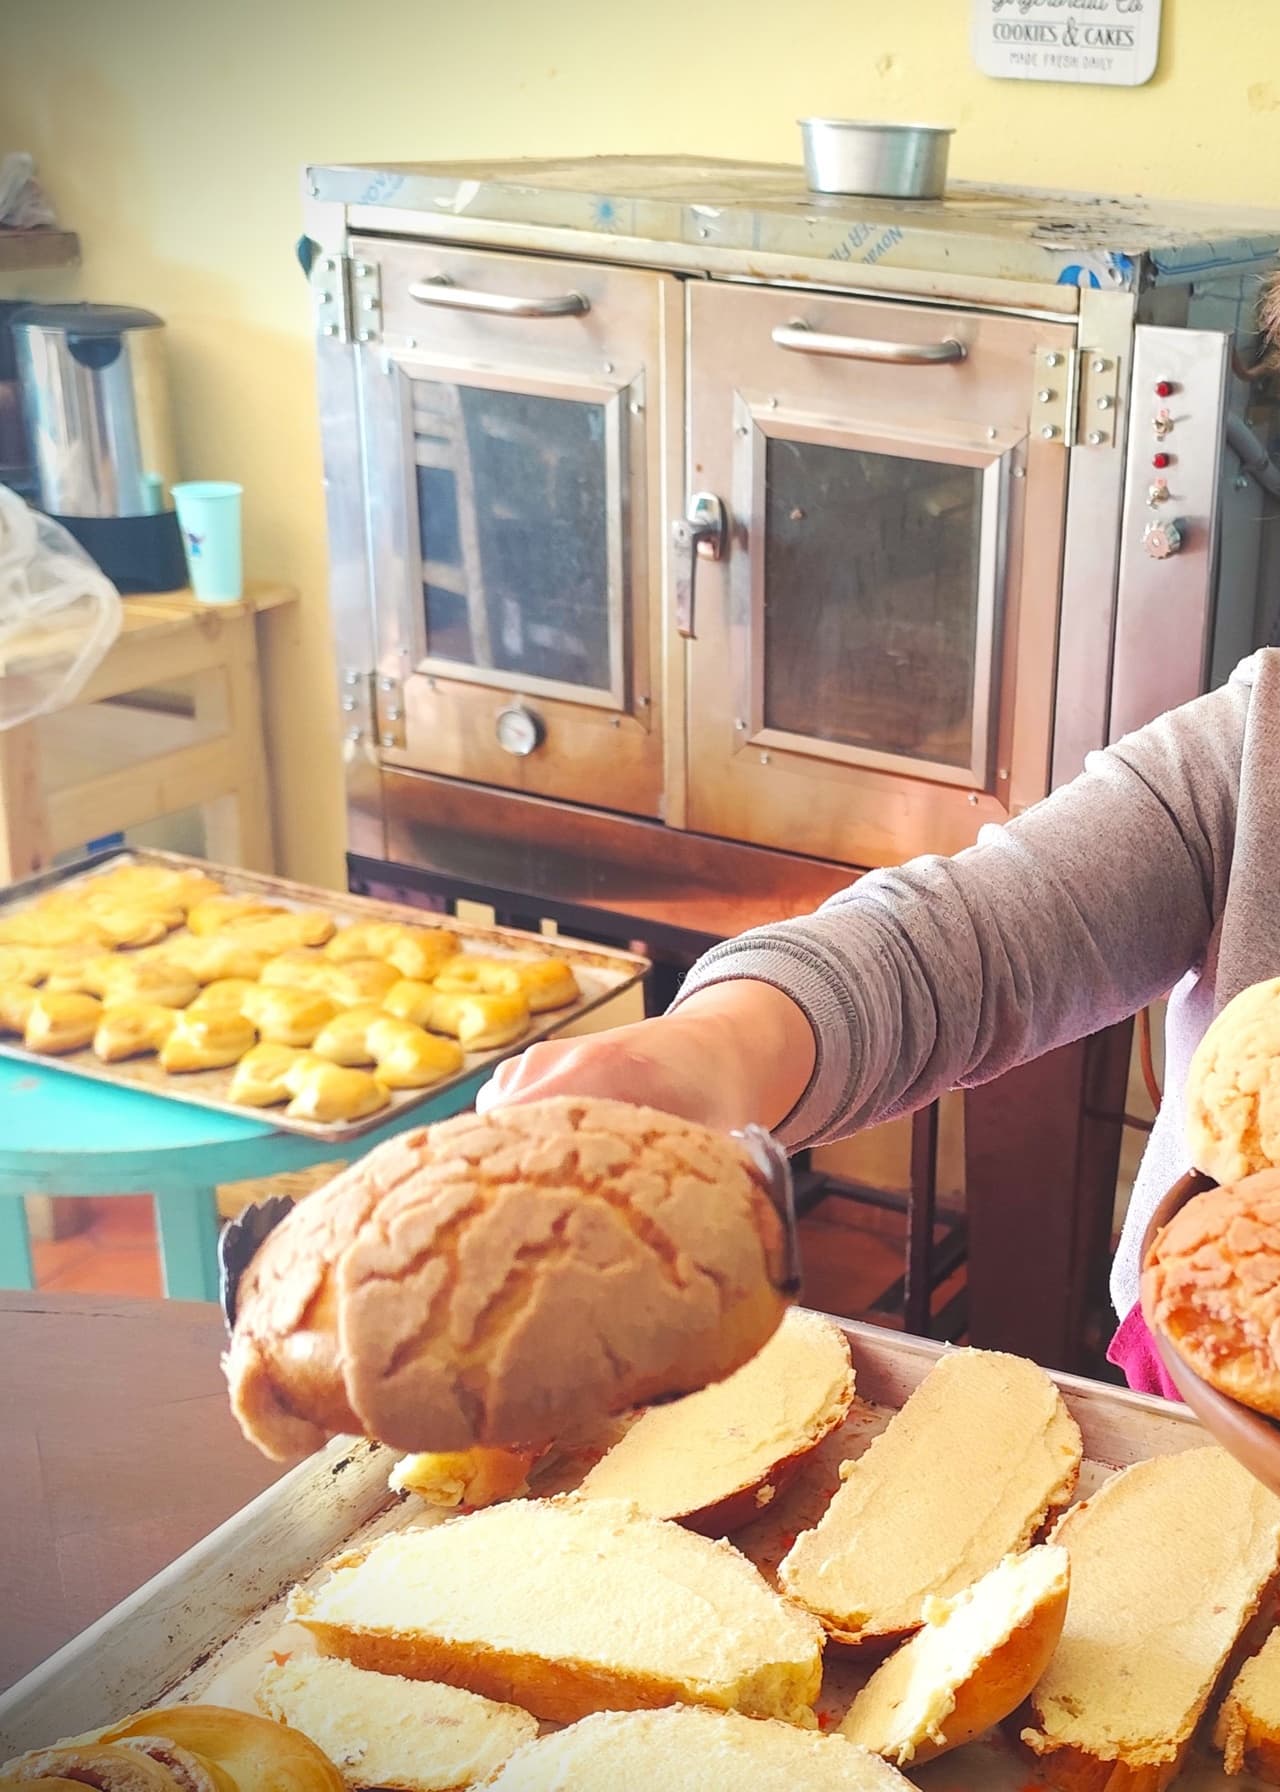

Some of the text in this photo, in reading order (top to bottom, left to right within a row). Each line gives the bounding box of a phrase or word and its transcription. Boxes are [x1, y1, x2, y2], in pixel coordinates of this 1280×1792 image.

[993, 16, 1135, 47] COOKIES & CAKES
[1009, 52, 1114, 71] MADE FRESH DAILY
